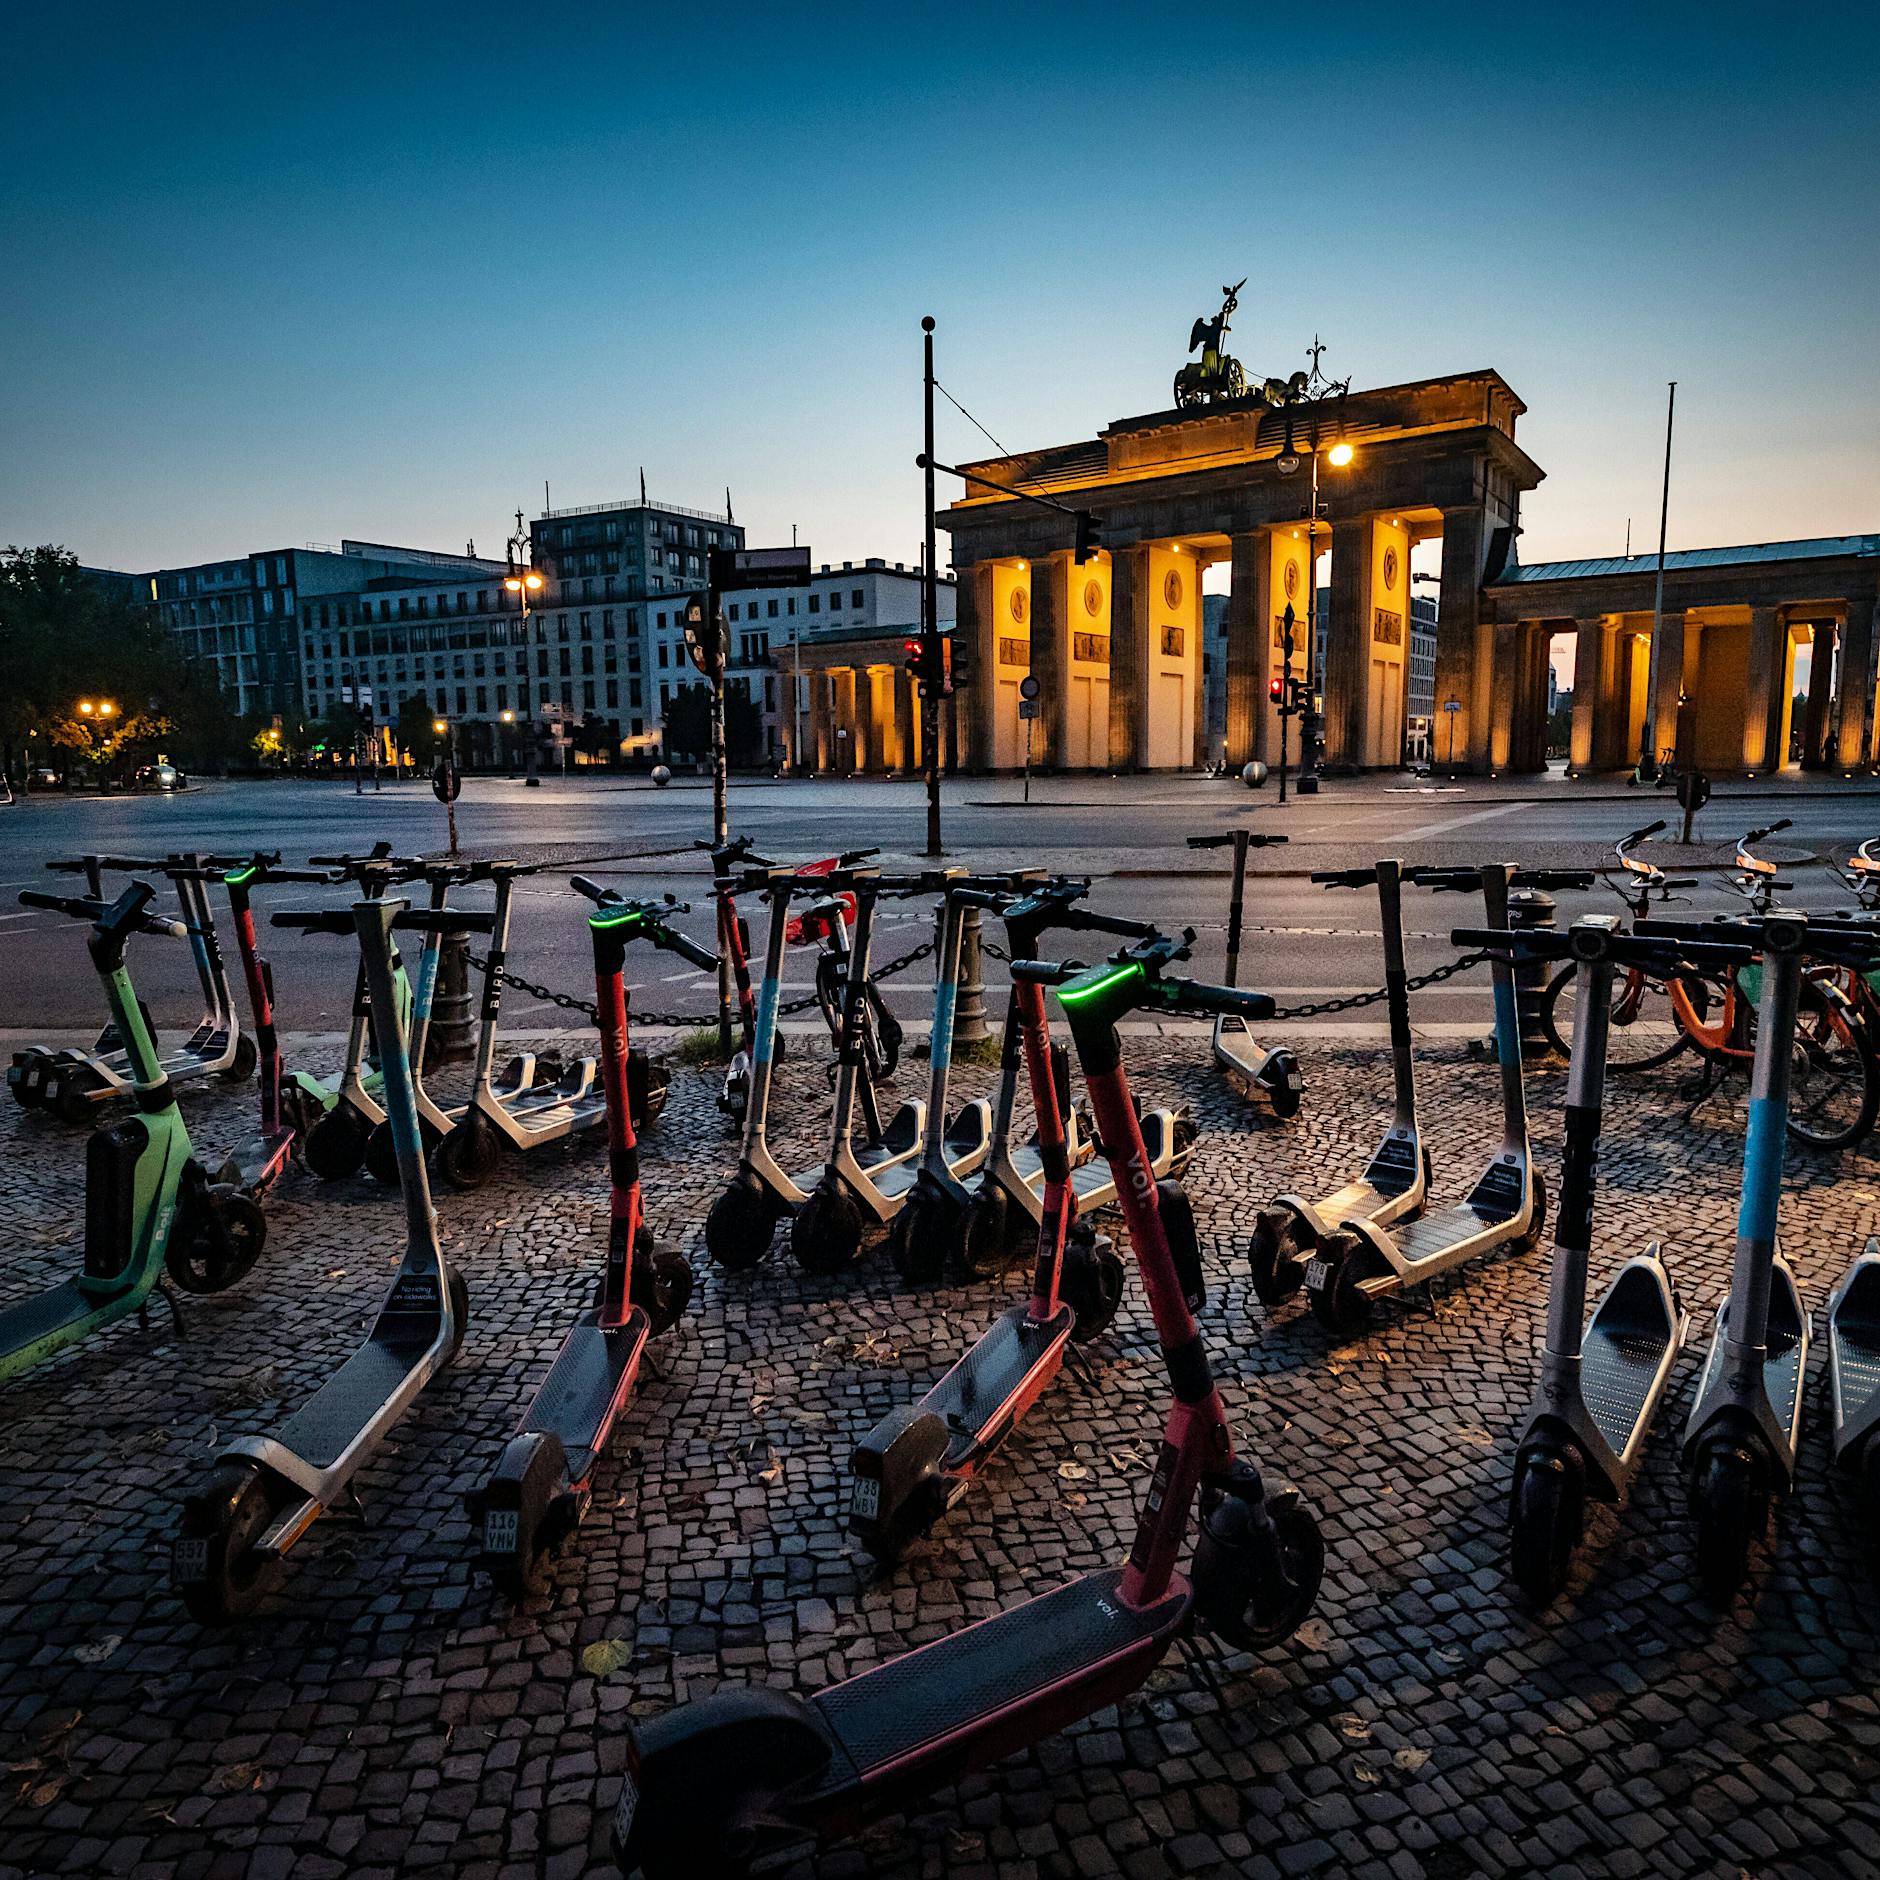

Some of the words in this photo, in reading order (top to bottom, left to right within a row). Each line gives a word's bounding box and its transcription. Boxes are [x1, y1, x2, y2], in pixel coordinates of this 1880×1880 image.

[490, 965, 503, 1008] BIRD
[850, 996, 865, 1050] BIRD
[857, 1478, 877, 1496] 738
[490, 1513, 515, 1529] 116
[177, 1542, 204, 1559] 557
